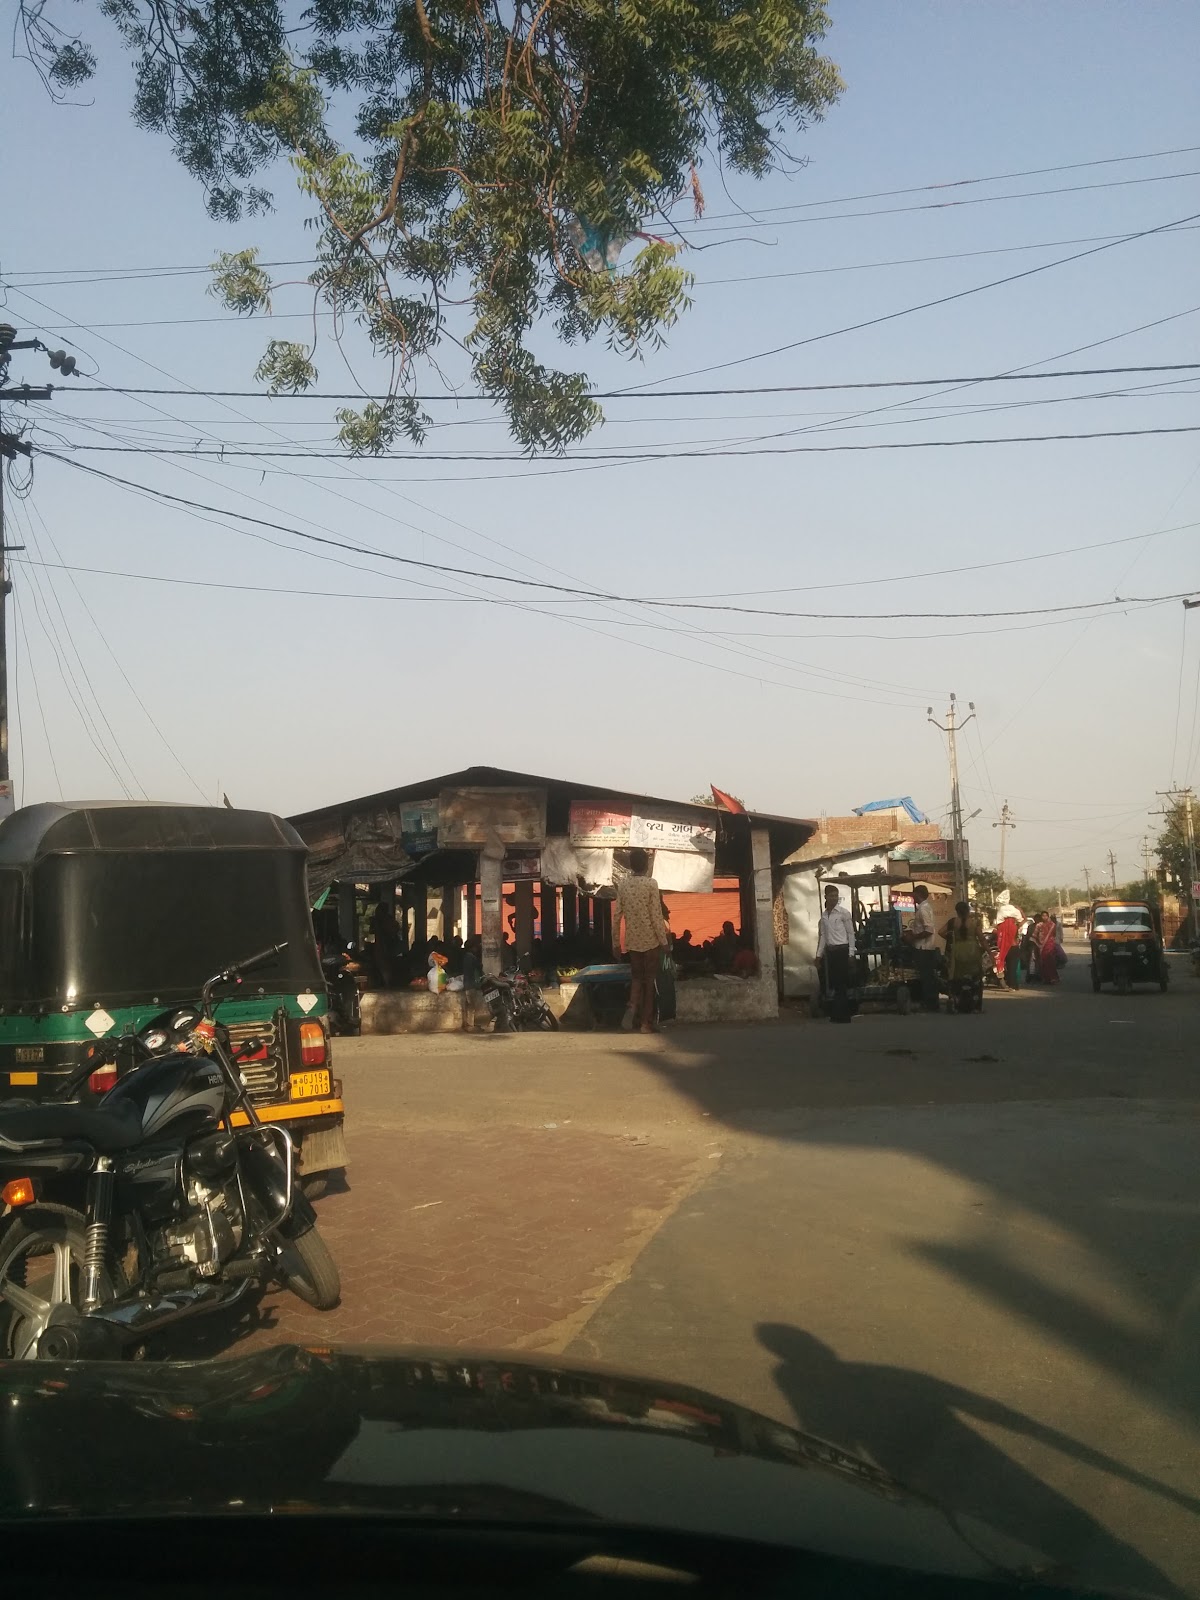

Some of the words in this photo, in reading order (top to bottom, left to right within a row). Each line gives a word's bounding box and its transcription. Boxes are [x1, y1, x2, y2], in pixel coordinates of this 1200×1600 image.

[646, 822, 664, 832] જય
[303, 1072, 323, 1085] GJ19
[299, 1086, 304, 1097] U
[310, 1082, 329, 1095] 7013
